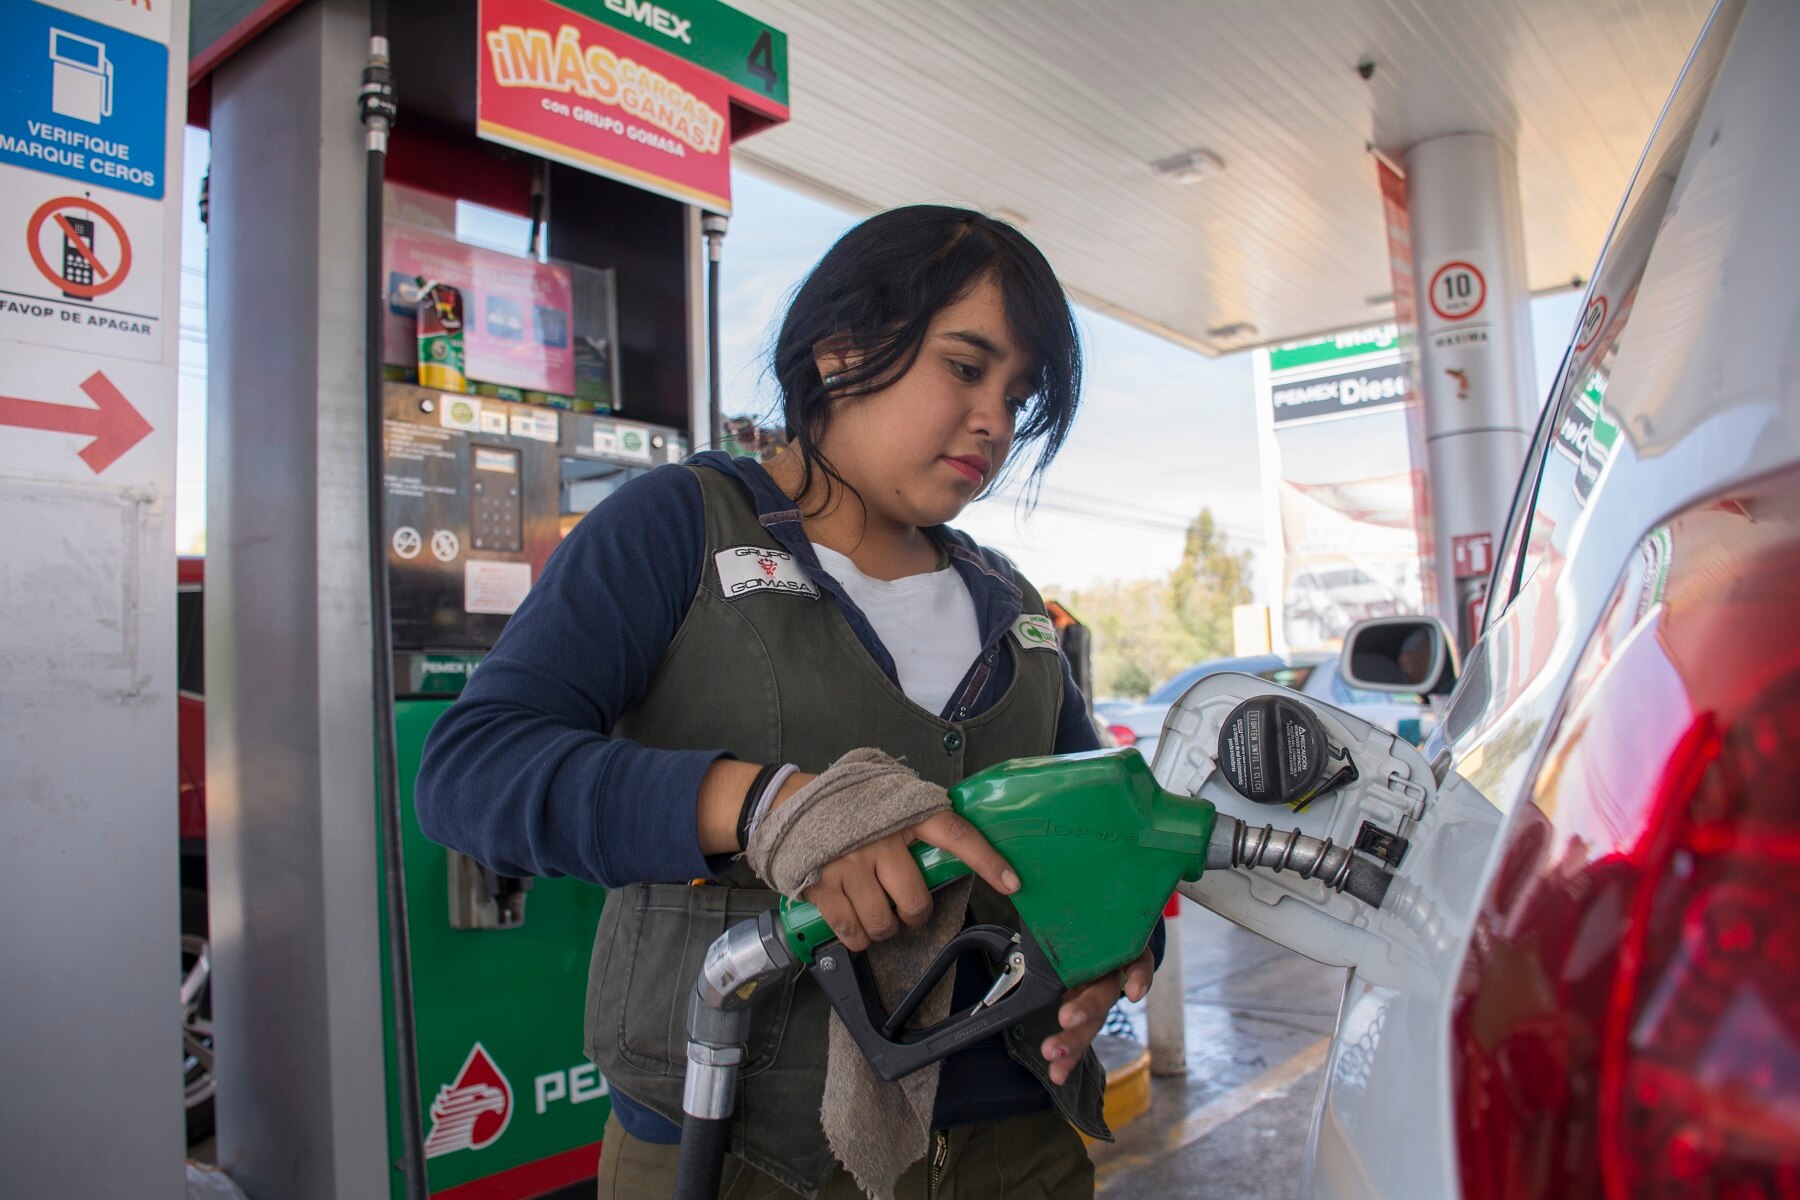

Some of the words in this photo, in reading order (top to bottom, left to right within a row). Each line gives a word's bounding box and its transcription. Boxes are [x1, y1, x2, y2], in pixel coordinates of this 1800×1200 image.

[747, 30, 778, 94] 4
[619, 59, 710, 125] CARGAS
[27, 119, 130, 161] VERIFIQUE
[541, 98, 571, 117] con
[572, 106, 625, 135] GRUPO
[626, 125, 686, 158] GOMASA
[0, 135, 85, 170] MARQUE
[89, 157, 155, 187] CEROS
[1444, 273, 1471, 299] 10
[0, 301, 54, 317] FAVOR
[60, 310, 82, 323] DE
[87, 315, 151, 335] APAGAR
[1273, 381, 1338, 408] PEMEX
[735, 548, 791, 560] GRUPO
[731, 578, 812, 593] GOMASA
[1250, 713, 1258, 741] TIGHTEN
[1251, 744, 1259, 763] UNTIL
[1253, 772, 1262, 791] CLICK
[535, 1061, 609, 1115] PE
